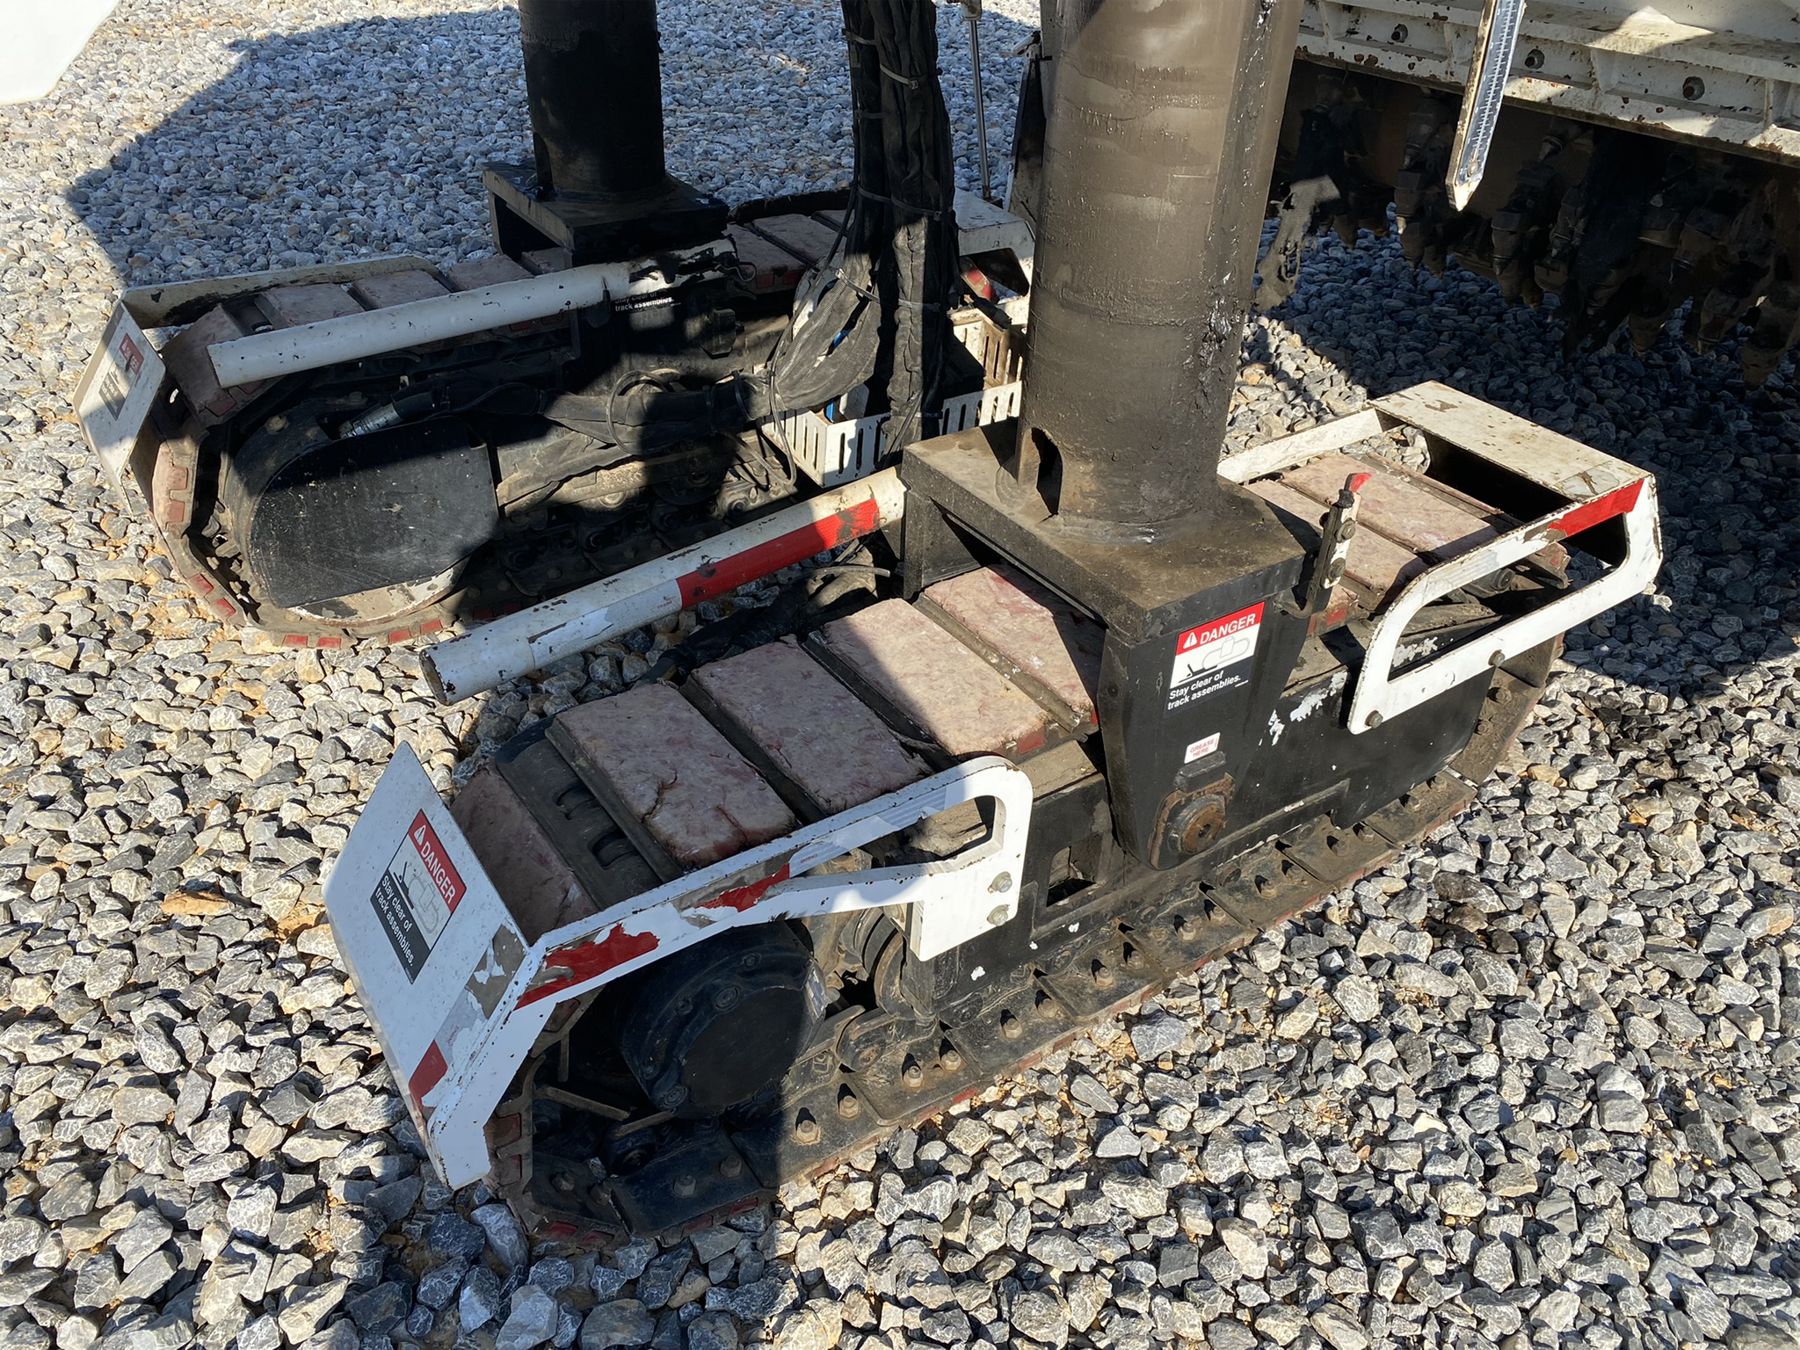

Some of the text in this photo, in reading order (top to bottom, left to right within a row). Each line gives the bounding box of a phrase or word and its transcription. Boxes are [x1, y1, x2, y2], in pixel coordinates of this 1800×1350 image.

[1200, 613, 1256, 644] DANGER
[1168, 695, 1189, 711] track
[1191, 675, 1241, 701] assemblies.
[1169, 670, 1224, 699] Stay clear of
[1189, 738, 1214, 755] GREASE
[419, 841, 456, 905] DANGER
[382, 874, 412, 933] Stay clear of
[374, 887, 387, 914] track
[386, 910, 414, 966] assemblies.
